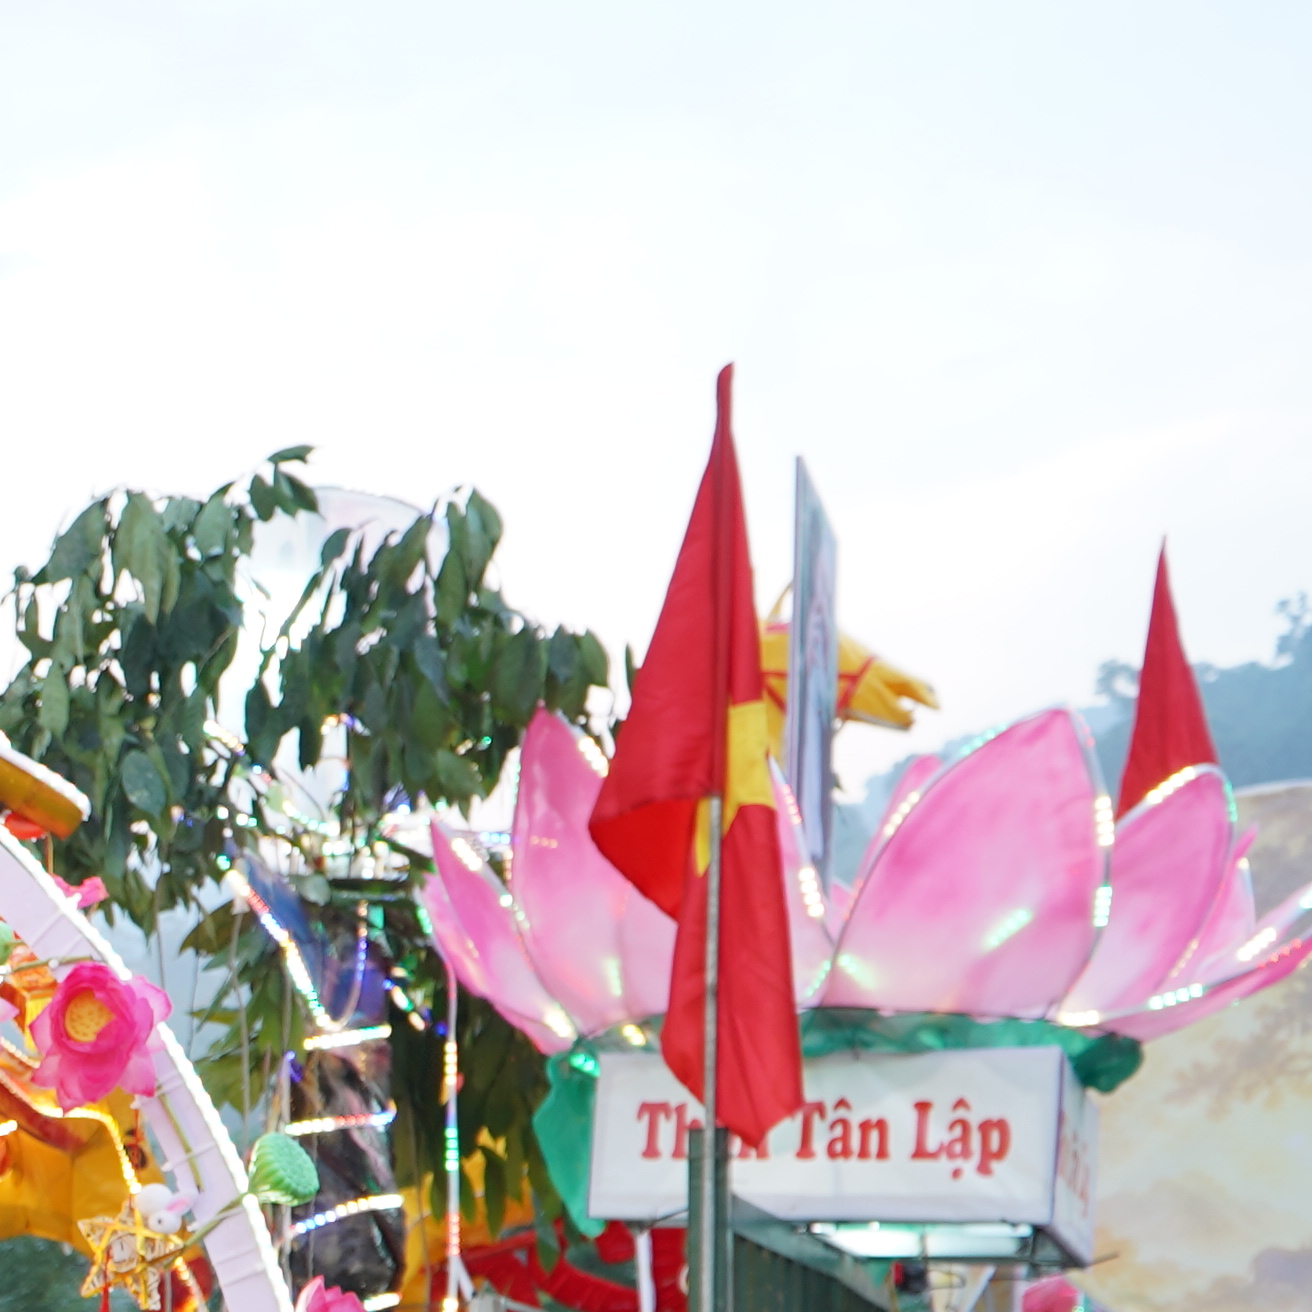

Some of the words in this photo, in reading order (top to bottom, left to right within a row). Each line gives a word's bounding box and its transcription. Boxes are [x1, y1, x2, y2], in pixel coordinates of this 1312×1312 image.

[637, 1100, 769, 1159] Thn
[791, 1097, 889, 1160] Tân
[910, 1097, 1011, 1180] Lập
